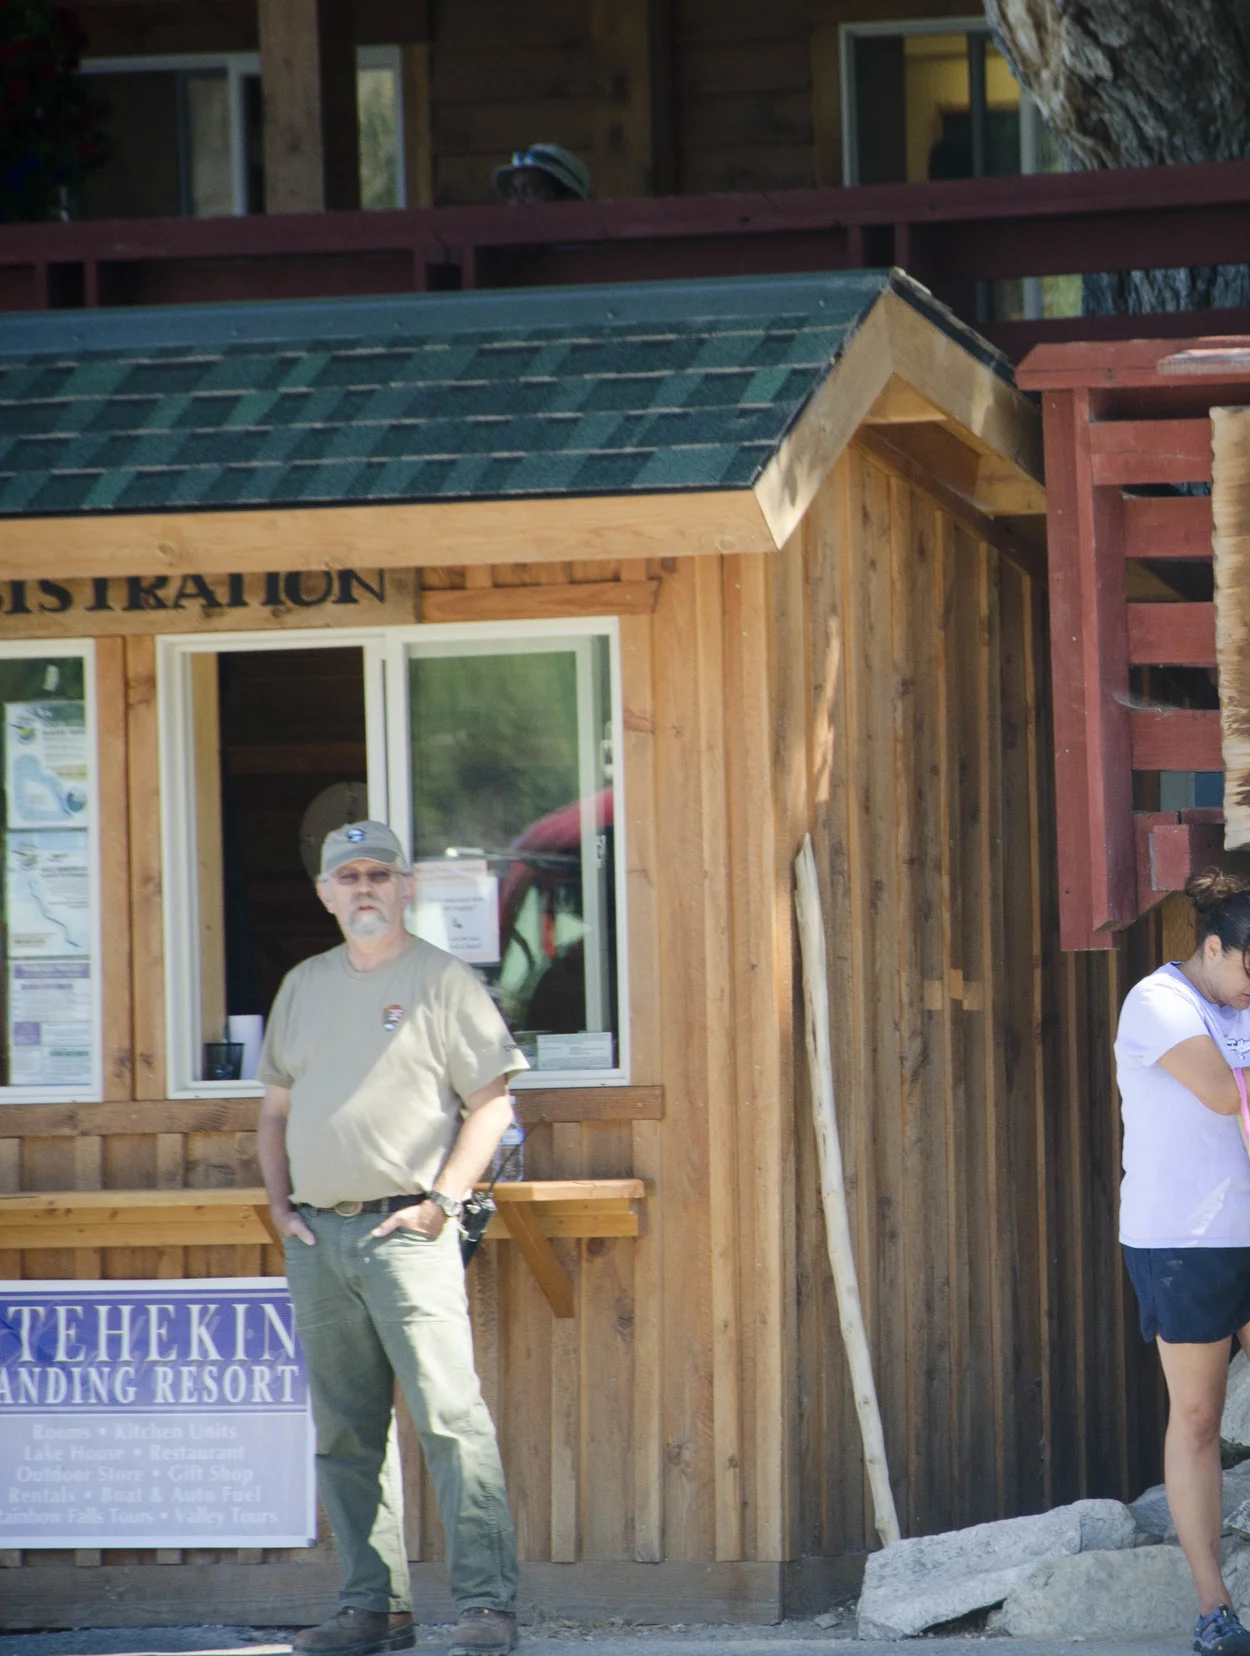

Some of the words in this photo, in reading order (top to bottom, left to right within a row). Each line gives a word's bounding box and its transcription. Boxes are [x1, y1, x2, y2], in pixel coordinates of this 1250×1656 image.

[0, 567, 387, 615] ISTRATION
[7, 1303, 297, 1363] TEHEKIN
[154, 1365, 299, 1403] RESORT
[32, 1424, 91, 1440] Rooms
[115, 1422, 182, 1439] Kitchen
[190, 1422, 237, 1439] Units
[24, 1445, 63, 1461] Lake
[70, 1445, 126, 1461] House
[149, 1444, 245, 1460] Restaurant
[16, 1465, 92, 1482] Outdoor
[98, 1465, 144, 1482] Store
[168, 1465, 203, 1482] Gift
[209, 1464, 254, 1485] Shop
[8, 1487, 76, 1503] Rentals
[101, 1486, 142, 1503] Boat
[172, 1487, 215, 1502] Auto
[222, 1485, 262, 1502] Fuel
[67, 1506, 103, 1523] Falls
[110, 1508, 154, 1524] Tours
[174, 1507, 224, 1528] Valley
[229, 1507, 278, 1524] Tours
